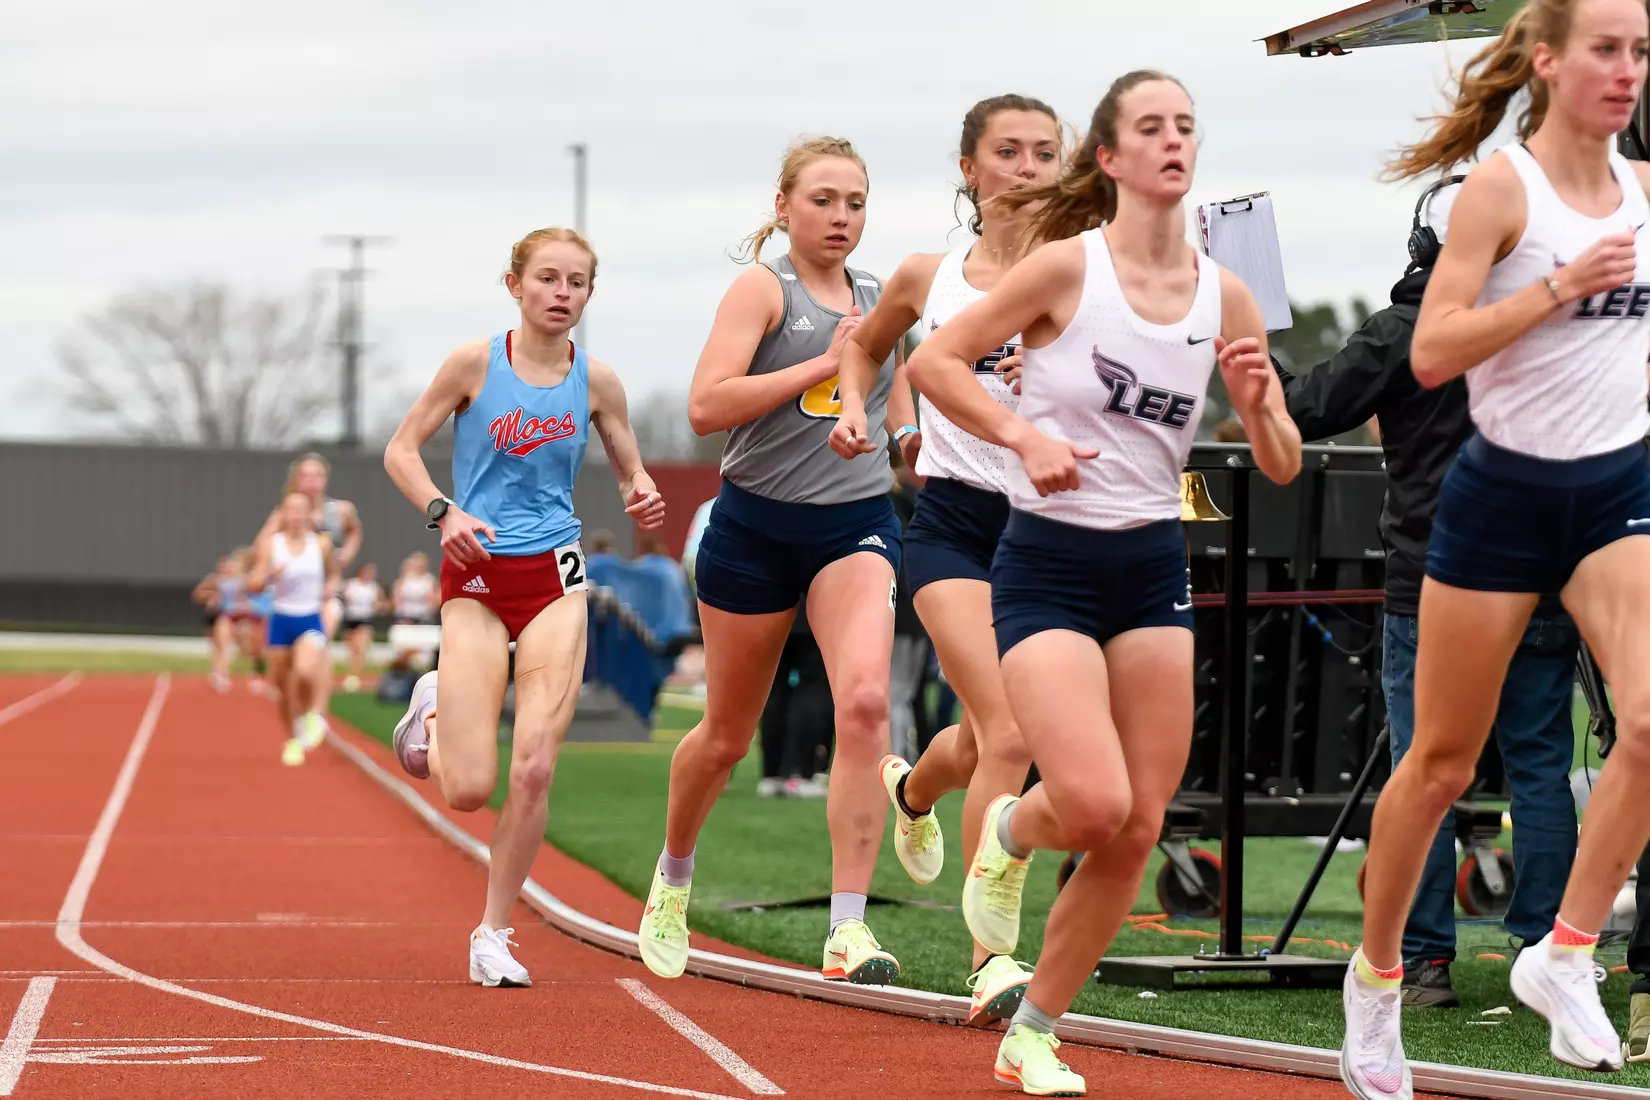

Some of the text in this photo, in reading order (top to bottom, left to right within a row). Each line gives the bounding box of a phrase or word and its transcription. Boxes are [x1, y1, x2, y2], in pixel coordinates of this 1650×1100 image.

[1571, 282, 1650, 320] LEE
[1103, 378, 1198, 430] LEE
[488, 407, 577, 457] Mocs
[858, 540, 887, 550] adidas
[560, 551, 584, 588] 2
[462, 585, 490, 593] adidas
